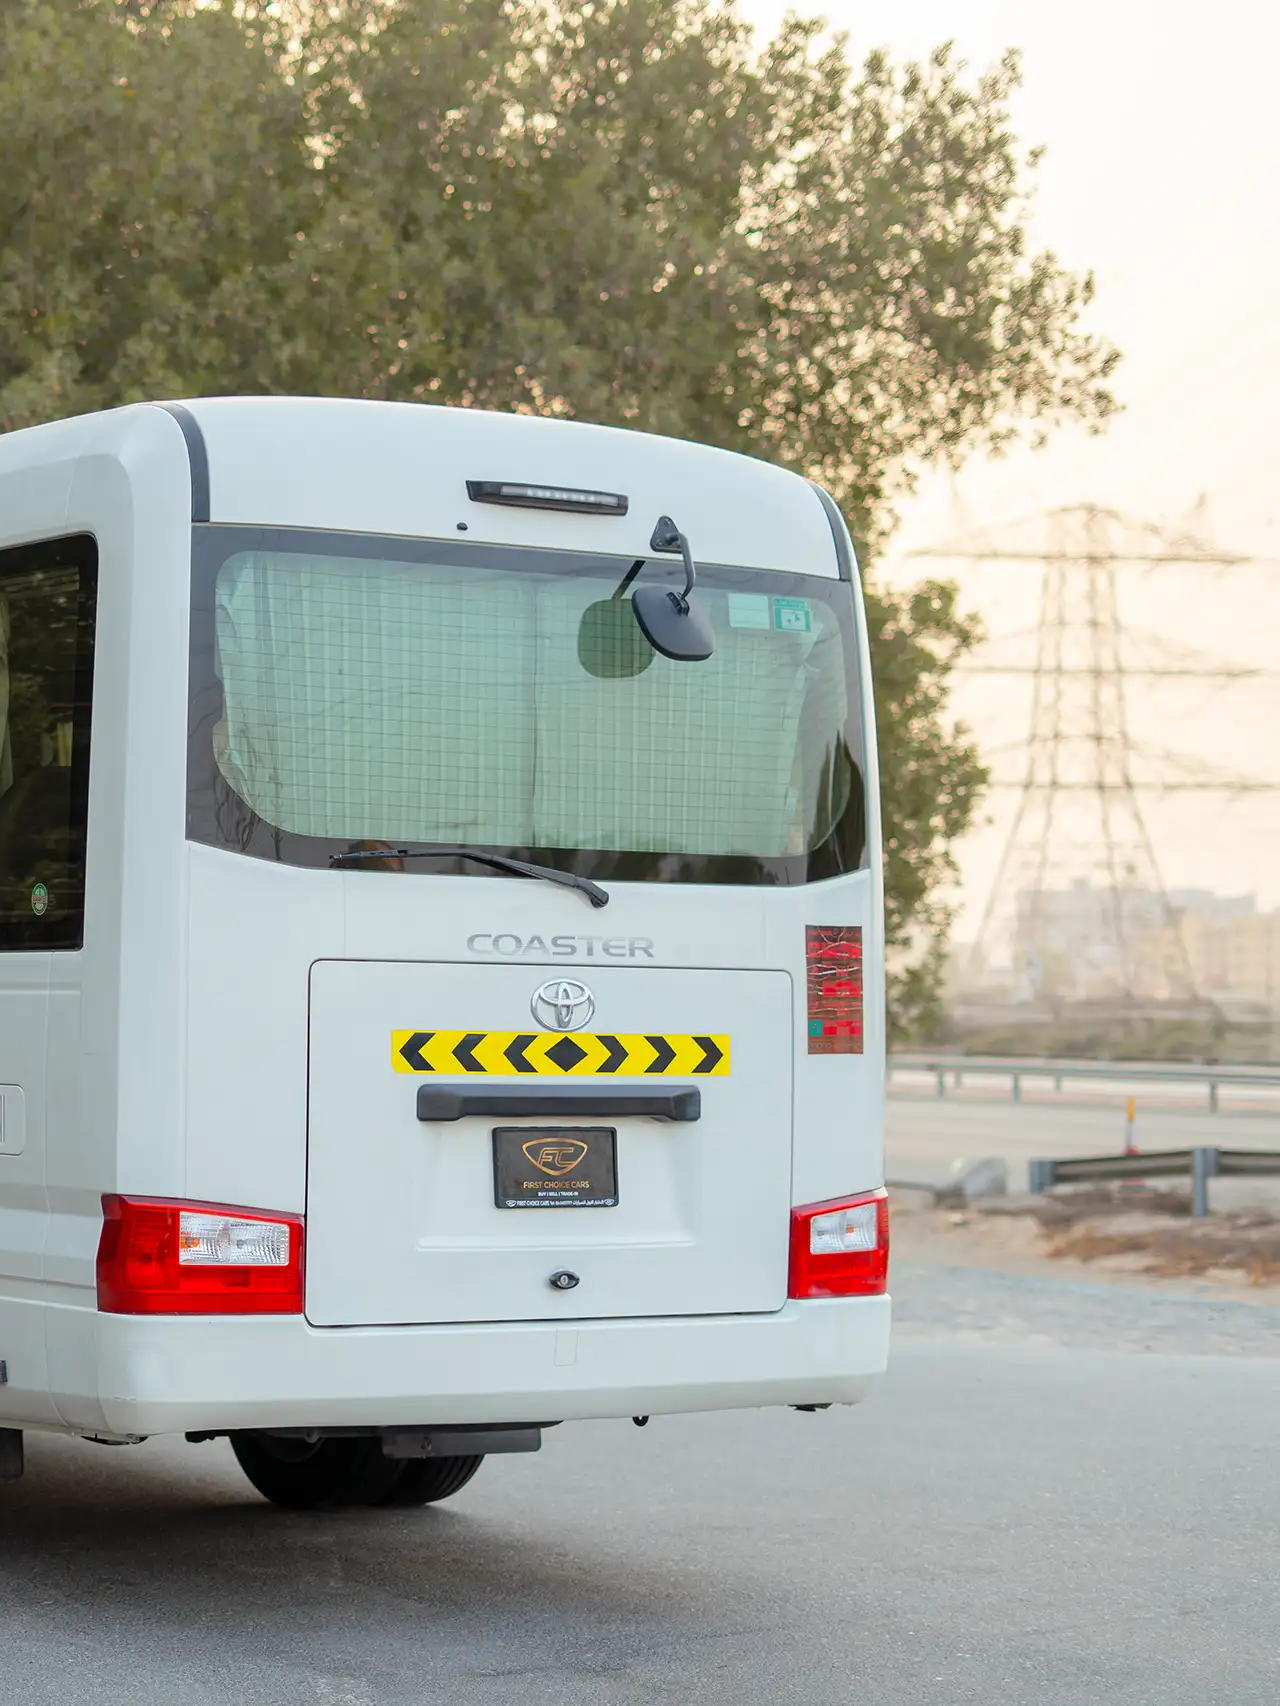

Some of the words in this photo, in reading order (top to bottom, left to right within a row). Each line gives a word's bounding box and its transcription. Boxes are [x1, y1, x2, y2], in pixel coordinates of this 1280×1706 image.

[467, 934, 655, 958] COASTER
[523, 1181, 542, 1189] FIRST
[544, 1181, 570, 1189] CHOICE
[571, 1181, 590, 1189] CARS
